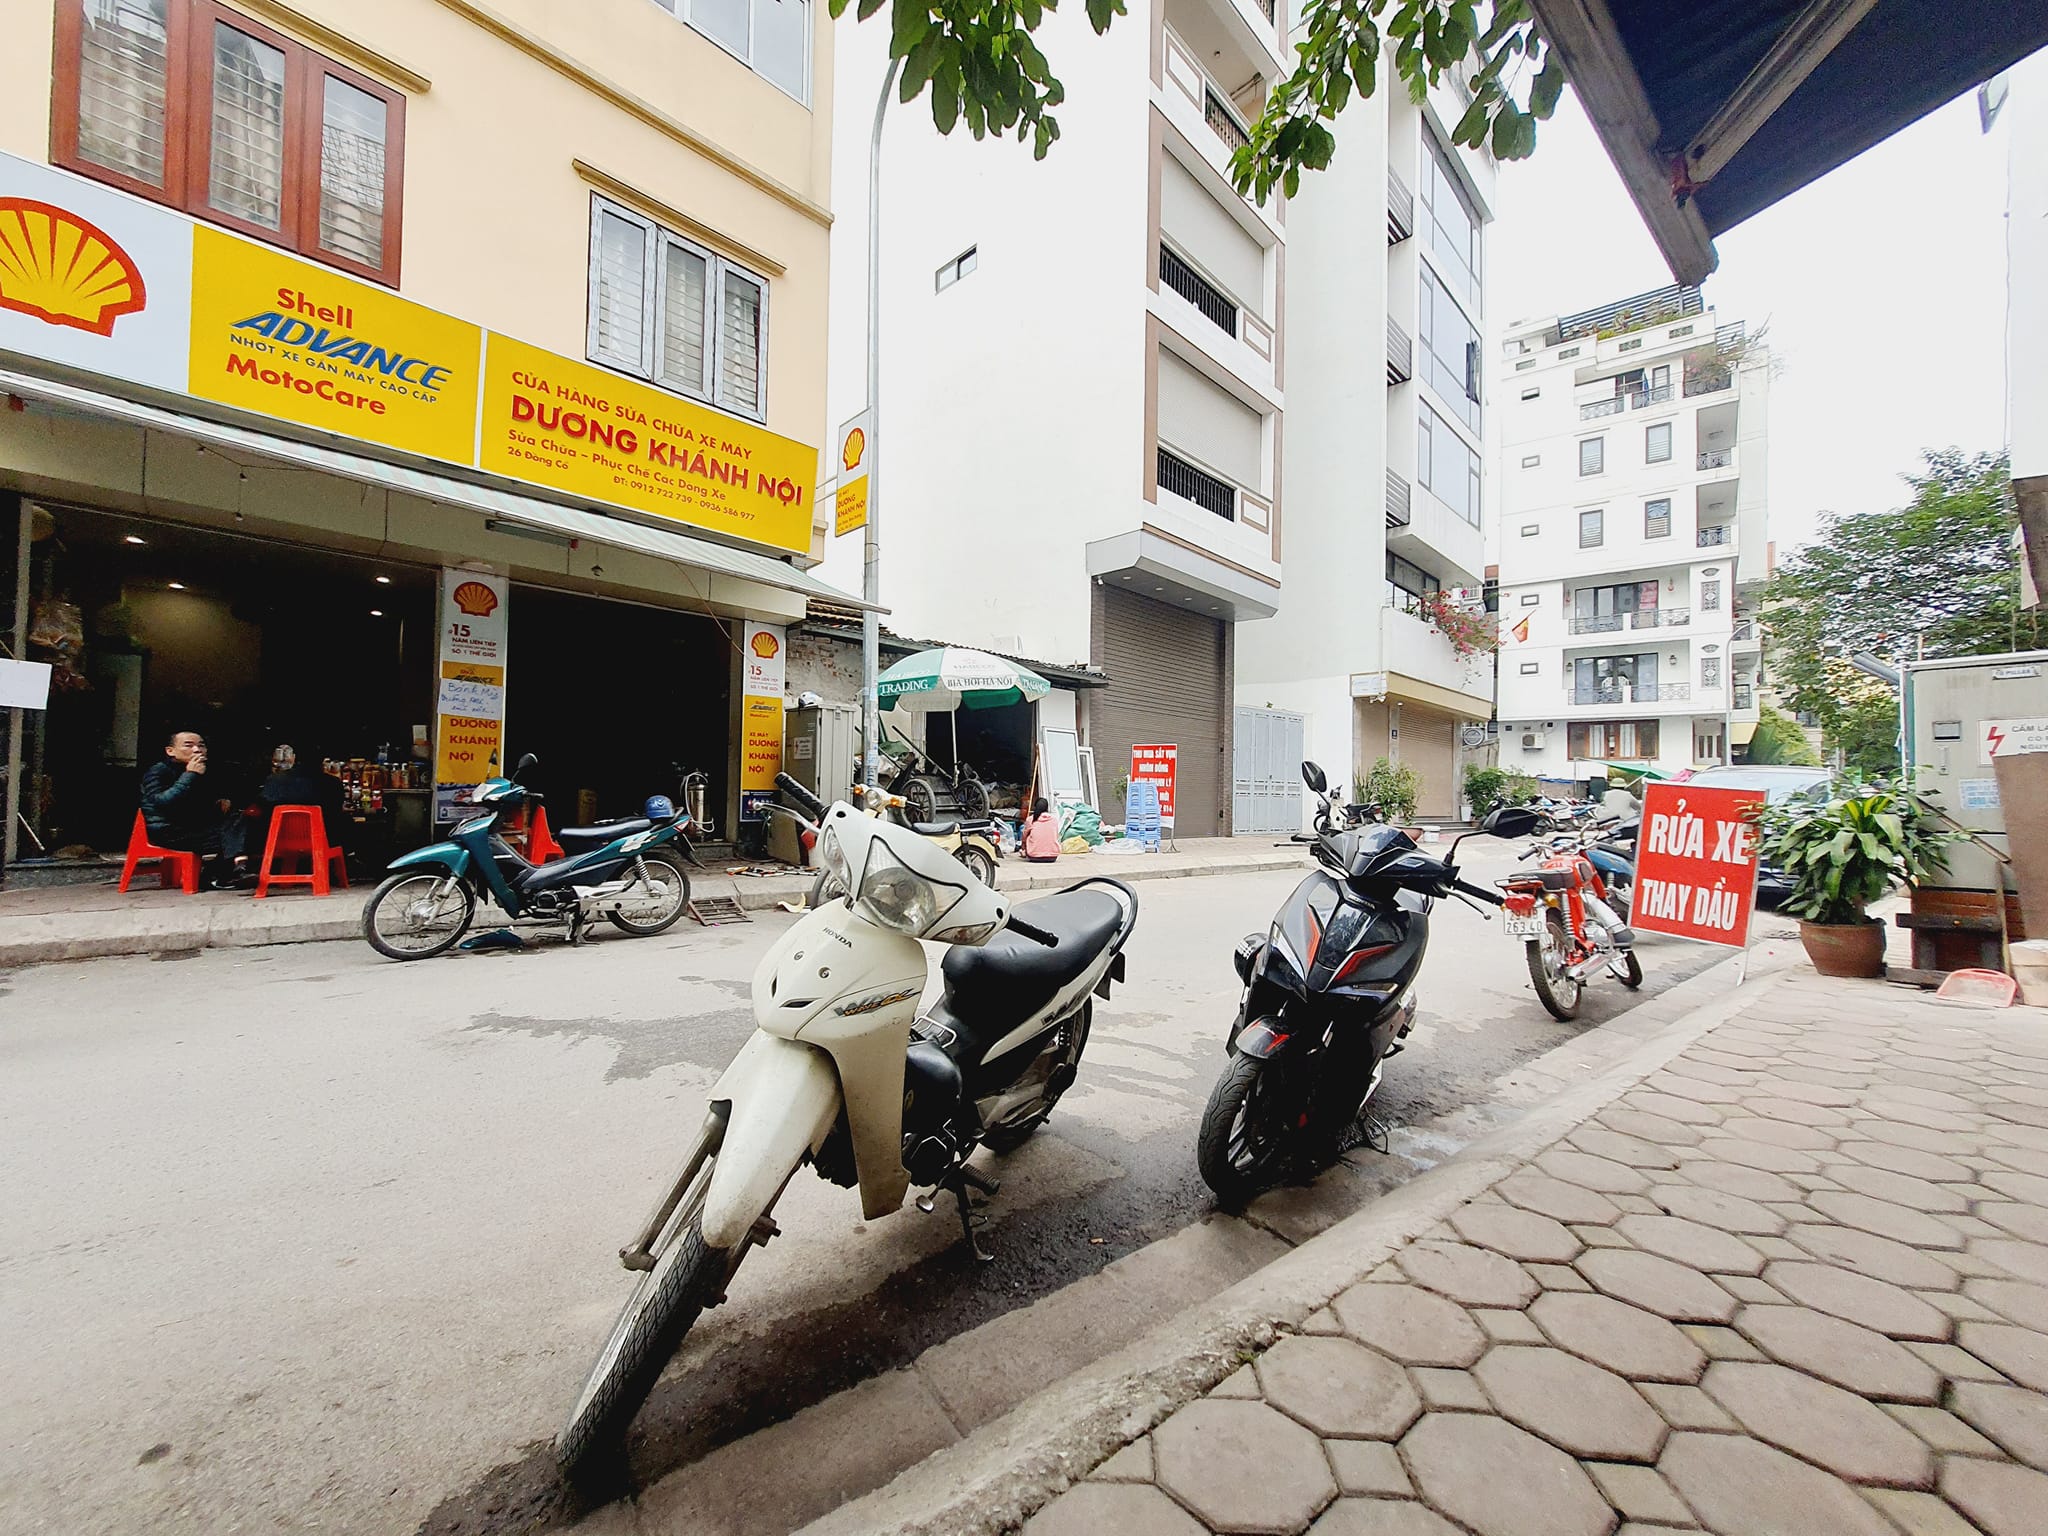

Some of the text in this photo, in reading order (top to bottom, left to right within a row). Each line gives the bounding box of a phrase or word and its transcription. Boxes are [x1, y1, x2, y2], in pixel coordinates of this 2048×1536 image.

[276, 288, 353, 330] Shell
[229, 311, 453, 391] ADVANCE
[226, 353, 386, 415] MotoCare
[281, 349, 300, 362] XE
[379, 380, 408, 395] CAO
[507, 446, 522, 457] 26
[511, 394, 802, 507] DƯƠNG KHÁNH NỘI
[700, 433, 717, 448] XE
[630, 480, 654, 494] 0912
[656, 487, 673, 499] 722
[676, 493, 693, 504] 739
[699, 499, 721, 513] 0936
[723, 507, 739, 517] 586
[740, 511, 755, 521] 977
[711, 488, 726, 500] Xe
[451, 623, 471, 637] 15
[750, 664, 762, 676] 15
[879, 679, 929, 696] TRADING
[1648, 798, 1754, 866] RỬA XE
[1640, 876, 1739, 931] THAY DẦU
[823, 927, 853, 949] HONDA
